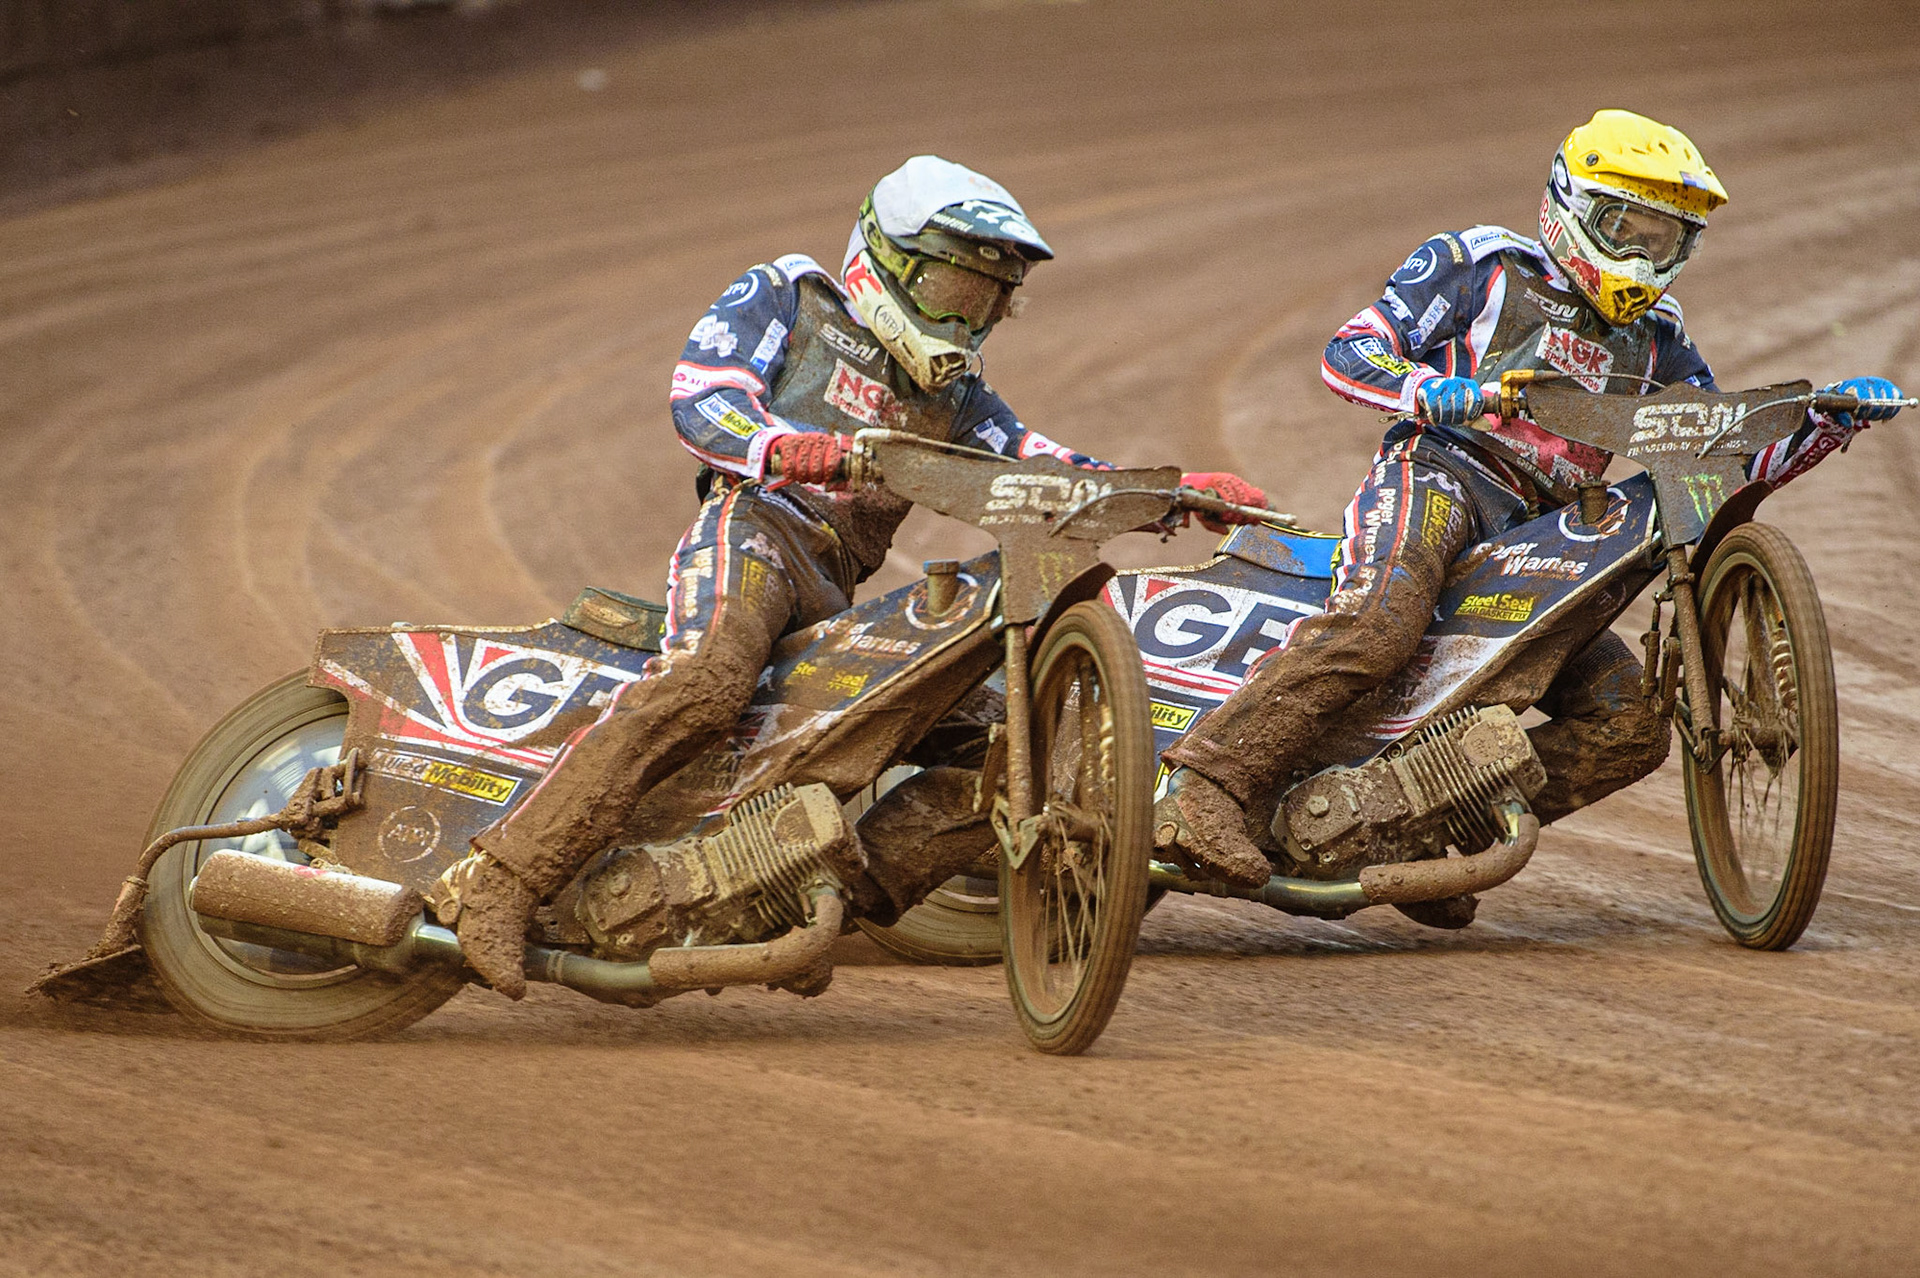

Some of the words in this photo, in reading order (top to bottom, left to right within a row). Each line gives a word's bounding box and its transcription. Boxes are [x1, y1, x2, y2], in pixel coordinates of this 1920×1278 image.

[1548, 332, 1608, 374] NGK
[836, 366, 902, 417] NG
[1377, 488, 1396, 525] Roger
[1501, 554, 1588, 577] Warnes
[1461, 593, 1499, 608] Steel
[1500, 594, 1535, 612] Seal
[1513, 611, 1529, 620] FIX
[1150, 704, 1188, 726] ility
[429, 765, 509, 798] Mobility
